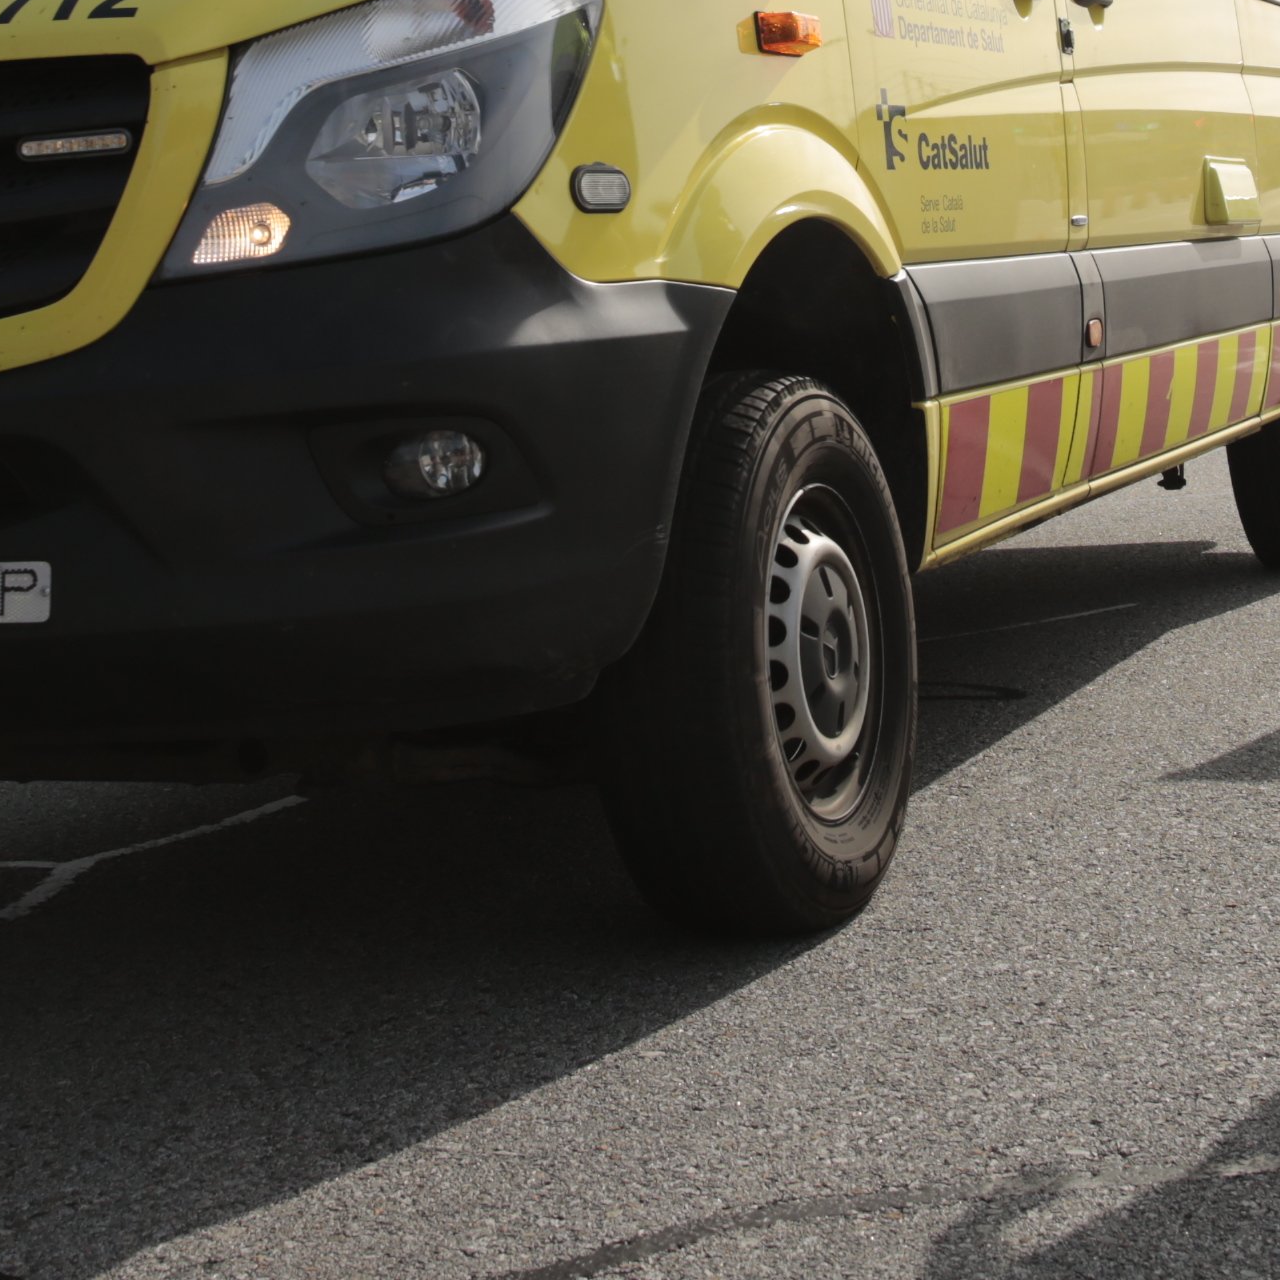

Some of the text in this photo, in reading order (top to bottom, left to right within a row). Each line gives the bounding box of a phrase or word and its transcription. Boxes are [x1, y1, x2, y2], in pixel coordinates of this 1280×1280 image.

[951, 0, 963, 18] de
[897, 15, 1005, 54] Departament de Salut
[917, 131, 990, 171] CatSalut
[921, 216, 931, 235] de
[939, 215, 957, 233] Salut
